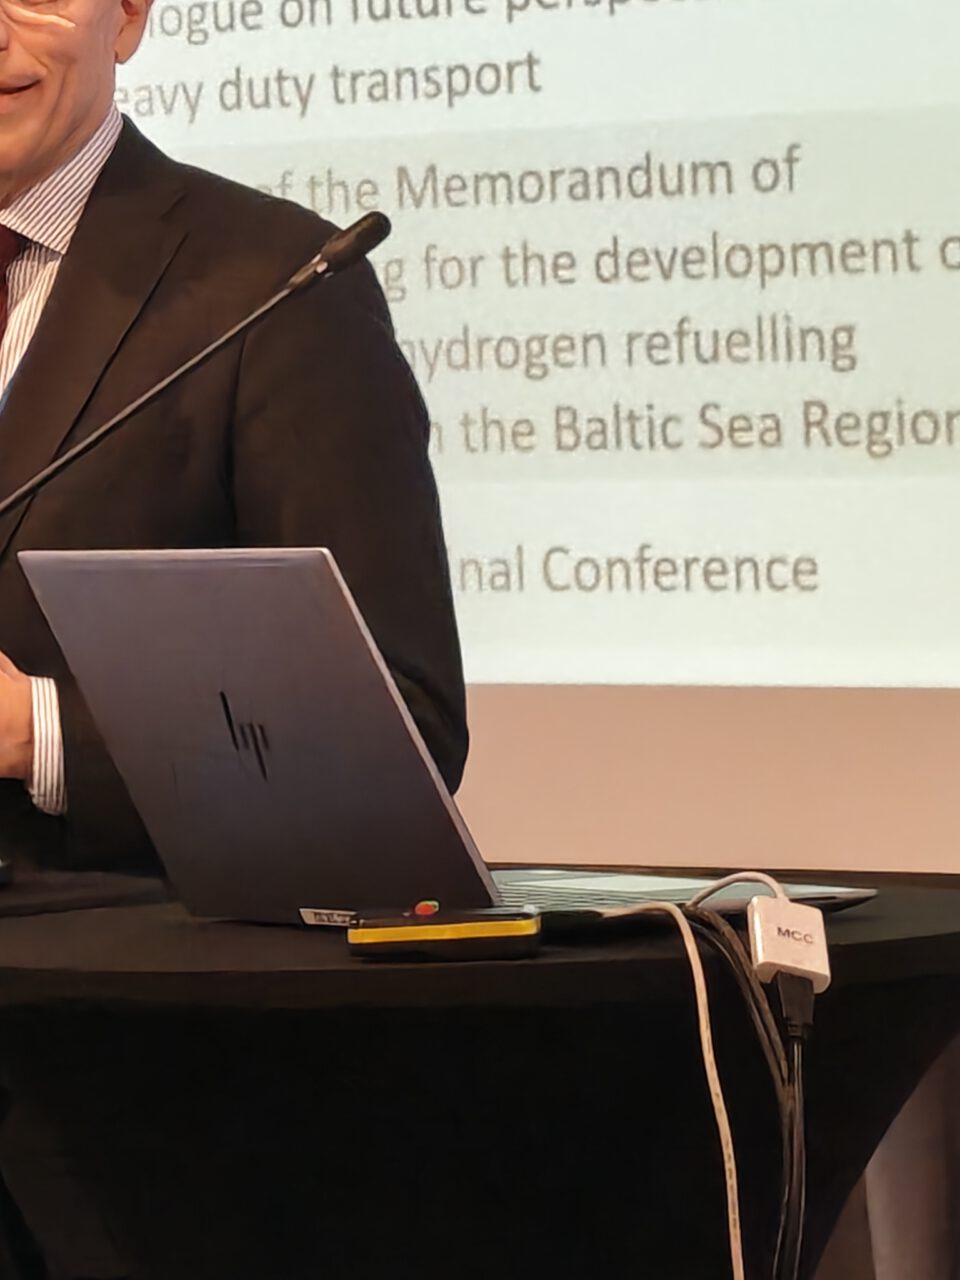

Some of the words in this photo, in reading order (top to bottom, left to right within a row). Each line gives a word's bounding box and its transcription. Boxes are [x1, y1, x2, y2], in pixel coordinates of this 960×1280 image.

[218, 66, 315, 119] duty
[331, 51, 542, 108] transport
[306, 168, 380, 214] the
[396, 151, 733, 211] Memorandum
[751, 144, 801, 194] of
[424, 243, 485, 290] for
[501, 238, 576, 287] the
[594, 227, 923, 290] development
[625, 313, 857, 372] refuelling
[460, 405, 537, 453] the
[554, 401, 682, 453] Baltic
[698, 402, 782, 448] Sea
[458, 544, 524, 593] nal
[542, 544, 819, 593] Conference
[777, 926, 814, 944] MCC
